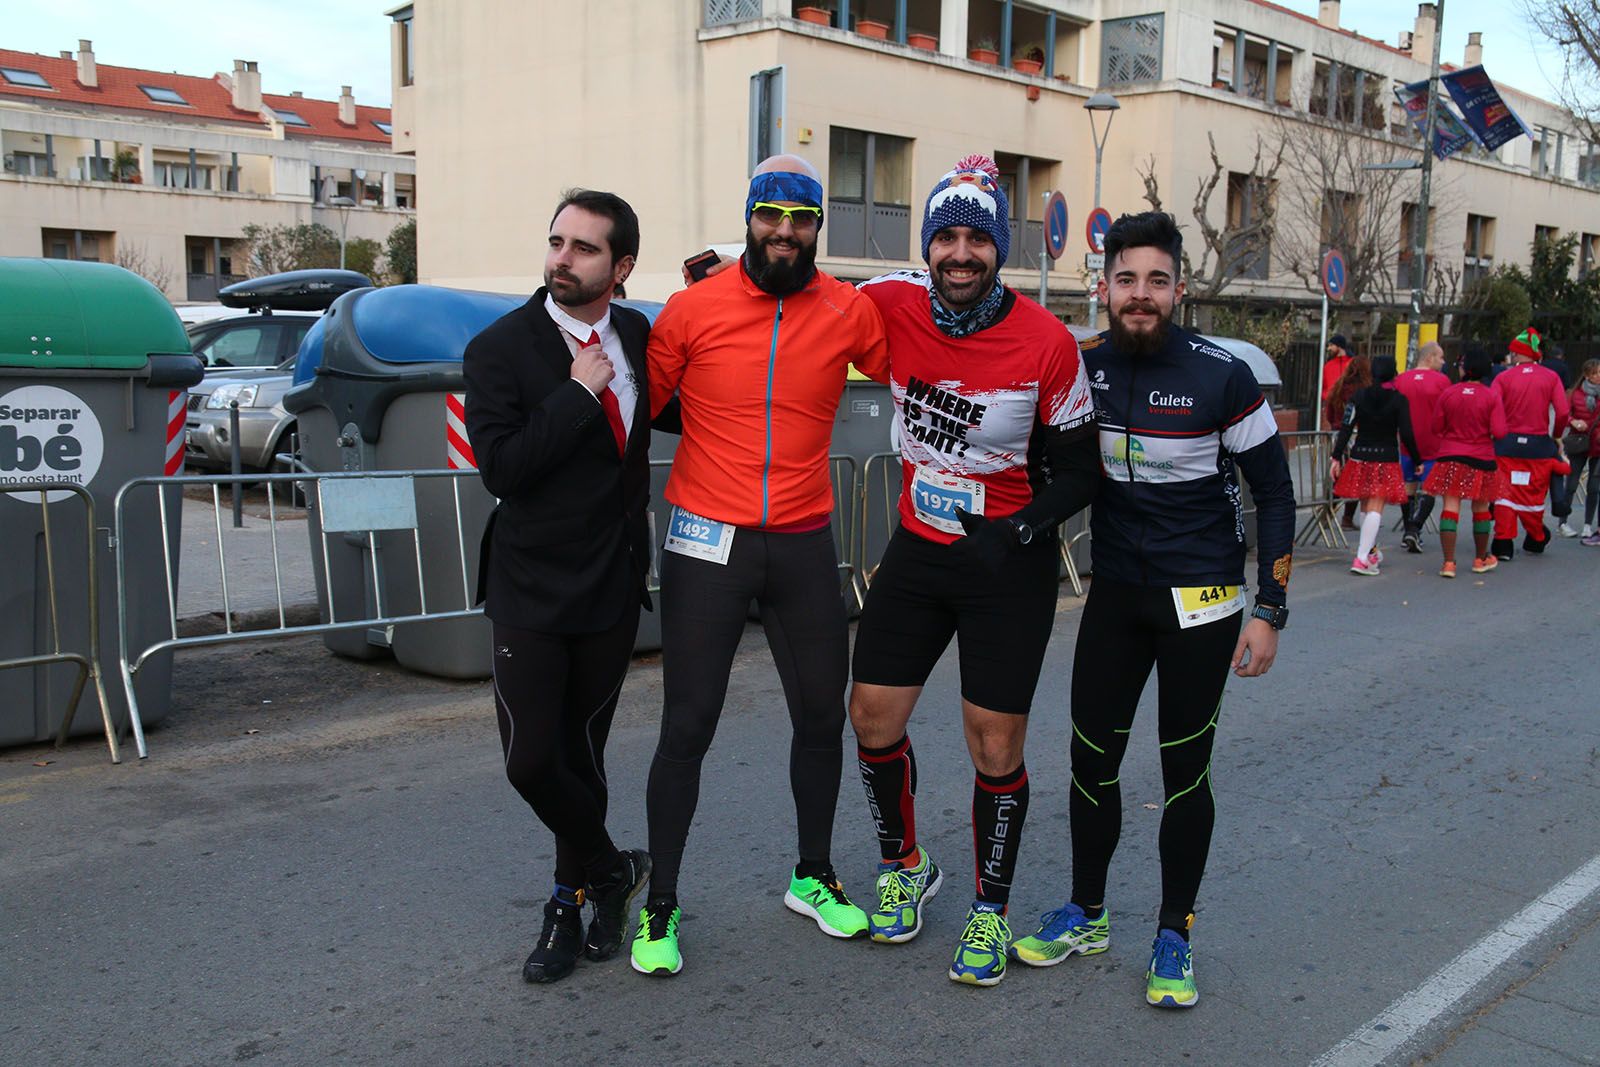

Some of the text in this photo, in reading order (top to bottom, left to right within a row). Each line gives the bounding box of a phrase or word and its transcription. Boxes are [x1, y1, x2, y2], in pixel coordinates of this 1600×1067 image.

[1199, 348, 1233, 363] Occidente
[905, 375, 987, 426] WHERE
[1148, 390, 1194, 407] Culets
[0, 405, 81, 423] Separar
[903, 397, 968, 440] IS THE
[1059, 417, 1083, 432] WHERE
[0, 424, 82, 472] bé
[1, 474, 82, 484] no costa tant
[678, 520, 711, 540] 1492
[1200, 585, 1227, 603] 441
[985, 795, 1018, 878] Kalenji
